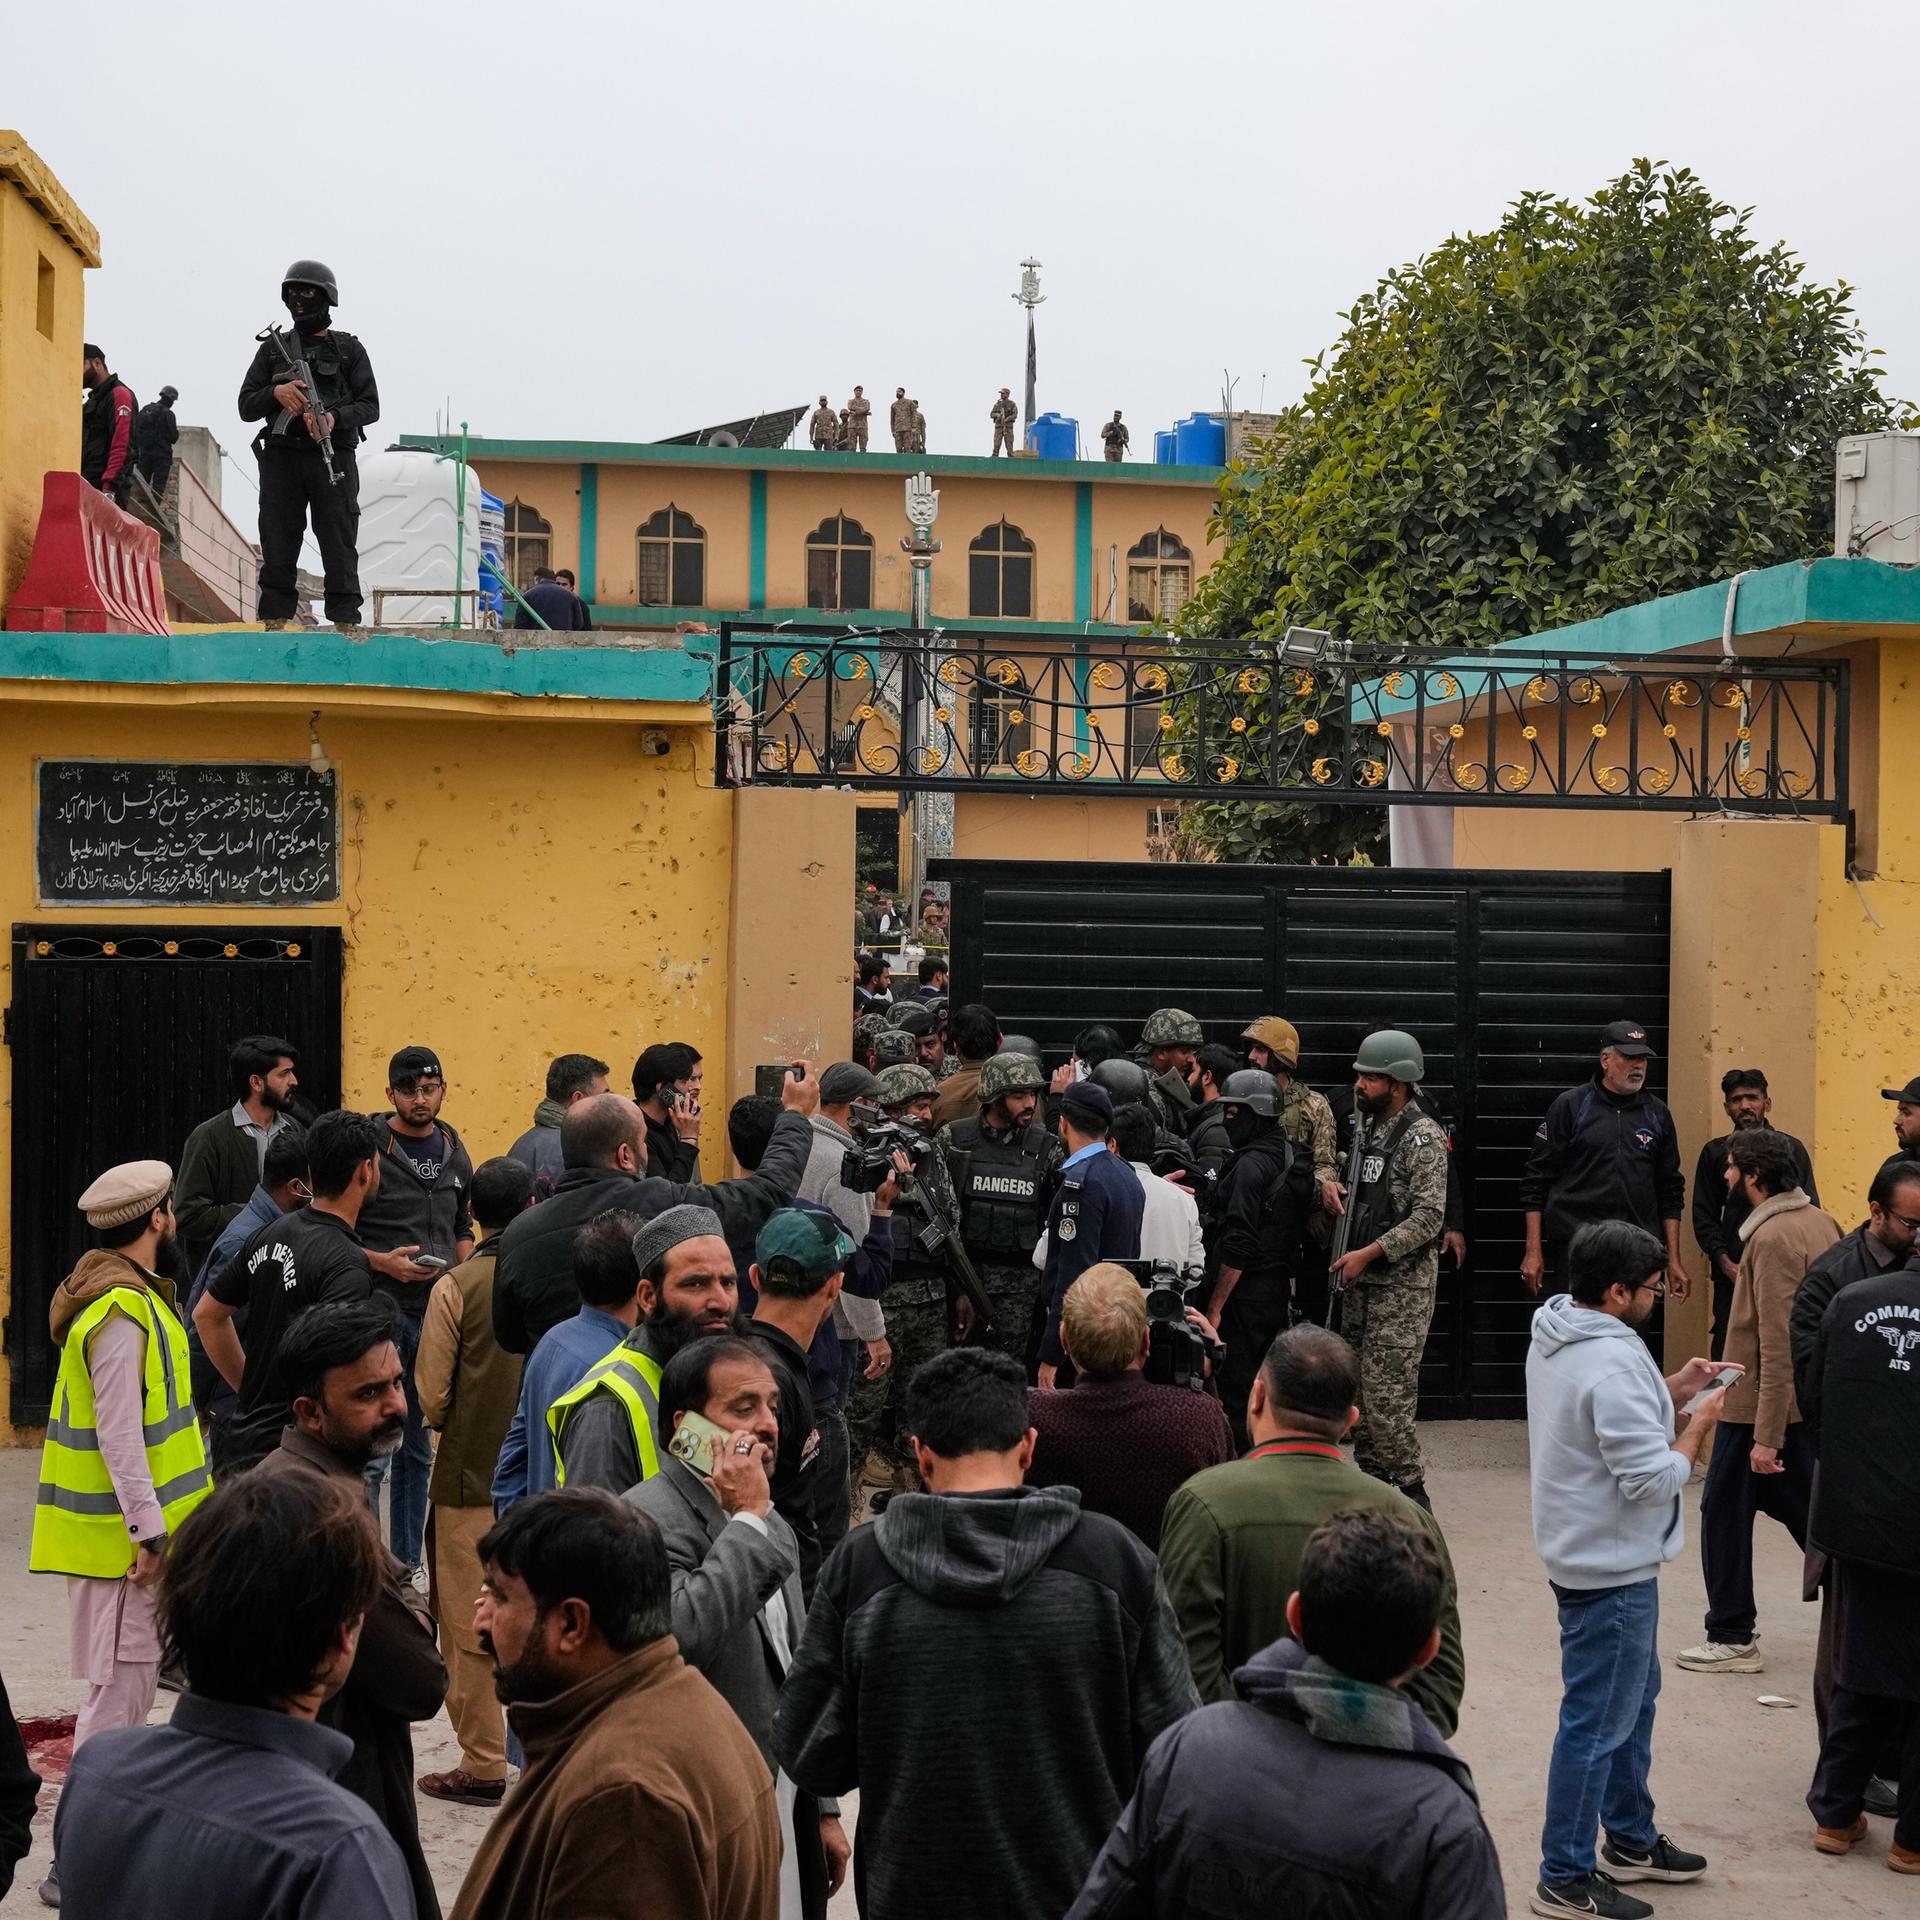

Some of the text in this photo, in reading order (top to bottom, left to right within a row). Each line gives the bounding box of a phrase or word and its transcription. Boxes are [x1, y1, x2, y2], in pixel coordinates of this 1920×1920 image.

[159, 786, 189, 827] ضلع
[184, 797, 225, 828] جعفریہ
[303, 790, 329, 824] دفتر
[92, 836, 108, 857] اللہ
[209, 868, 230, 898] امام
[258, 866, 291, 896] جامع
[291, 862, 331, 895] مرکزی
[973, 1175, 1035, 1196] RANGERS
[248, 1244, 268, 1275] CIVIL
[1889, 1359, 1911, 1371] ATS
